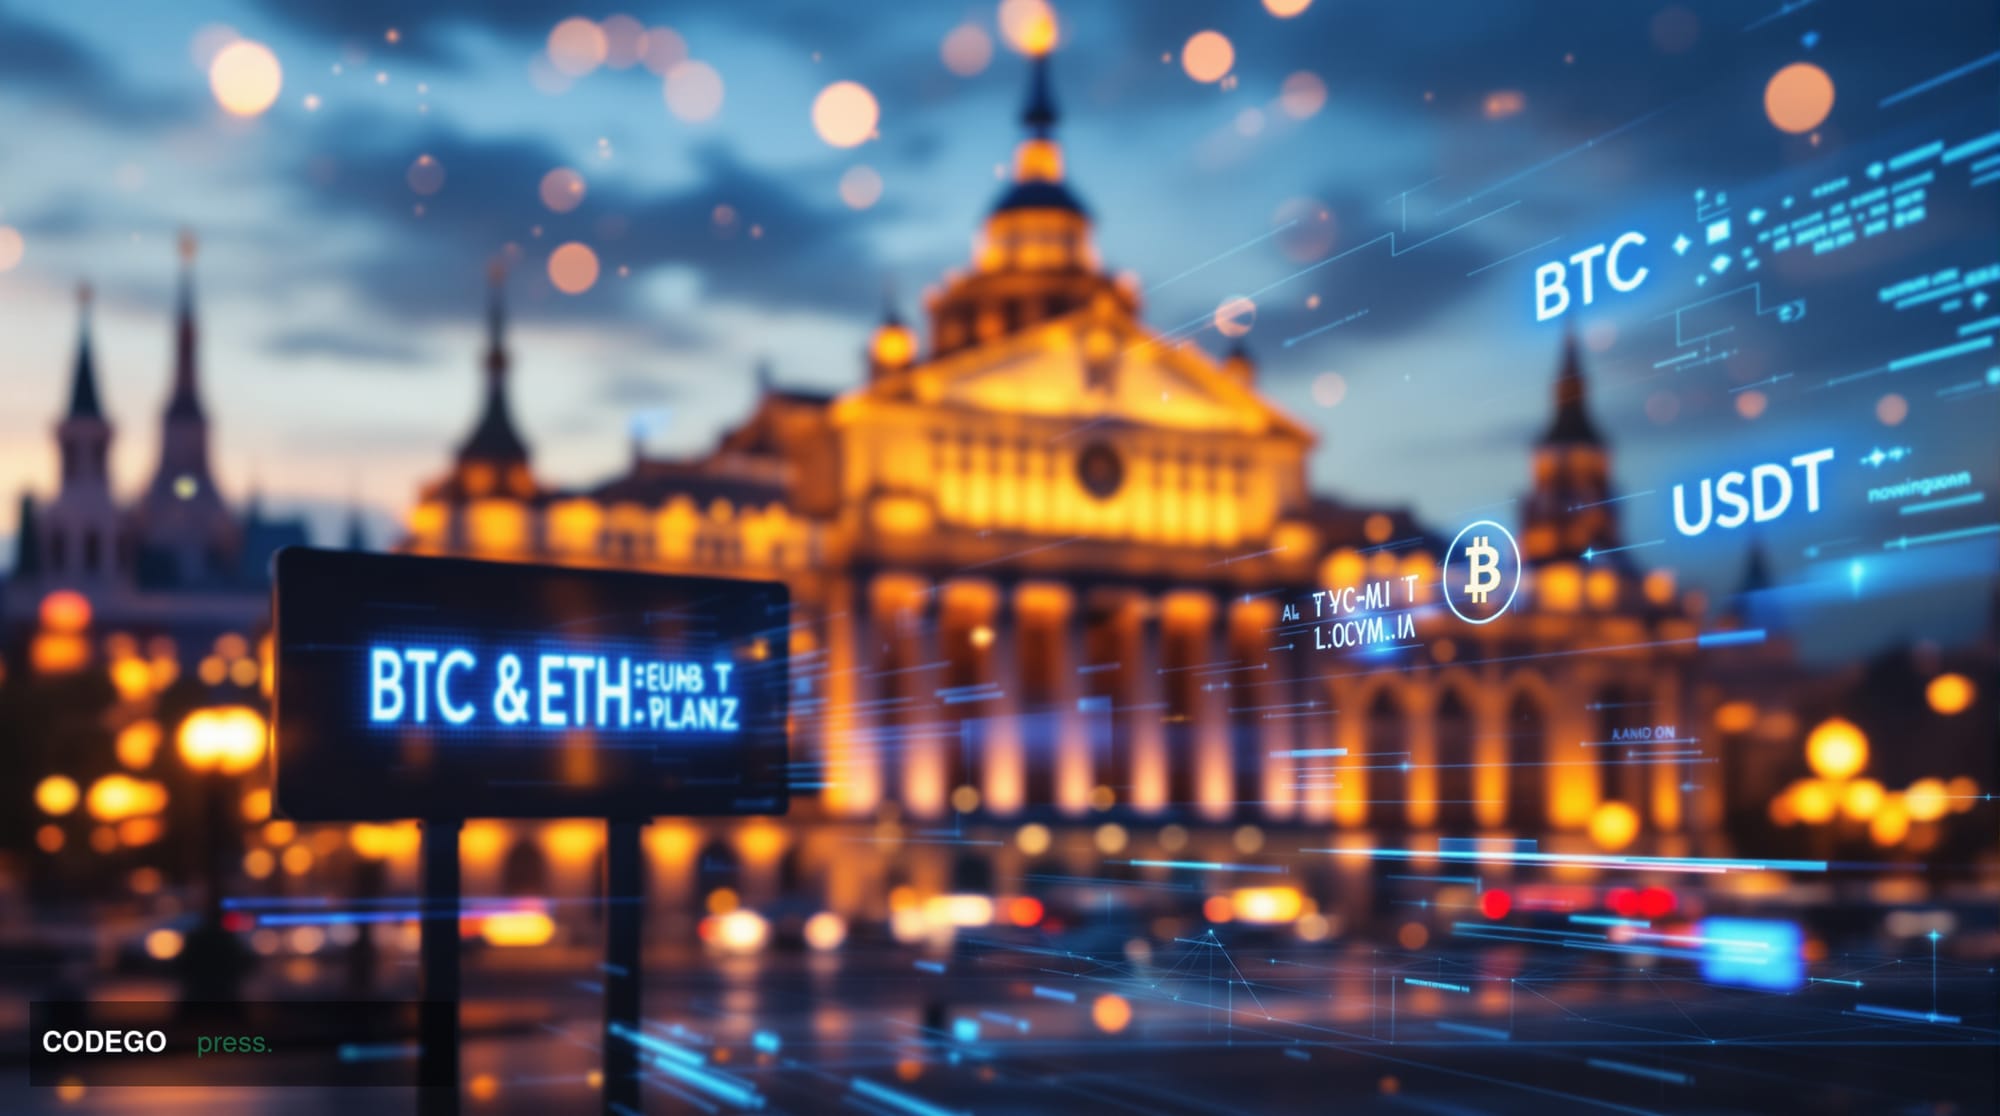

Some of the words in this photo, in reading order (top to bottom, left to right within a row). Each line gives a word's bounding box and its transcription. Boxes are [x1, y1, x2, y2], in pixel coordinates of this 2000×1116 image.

[1535, 231, 1649, 322] BTC
[1673, 448, 1834, 536] USDT
[370, 647, 476, 724] BTC
[494, 653, 530, 725] &
[649, 697, 740, 729] PLANZ
